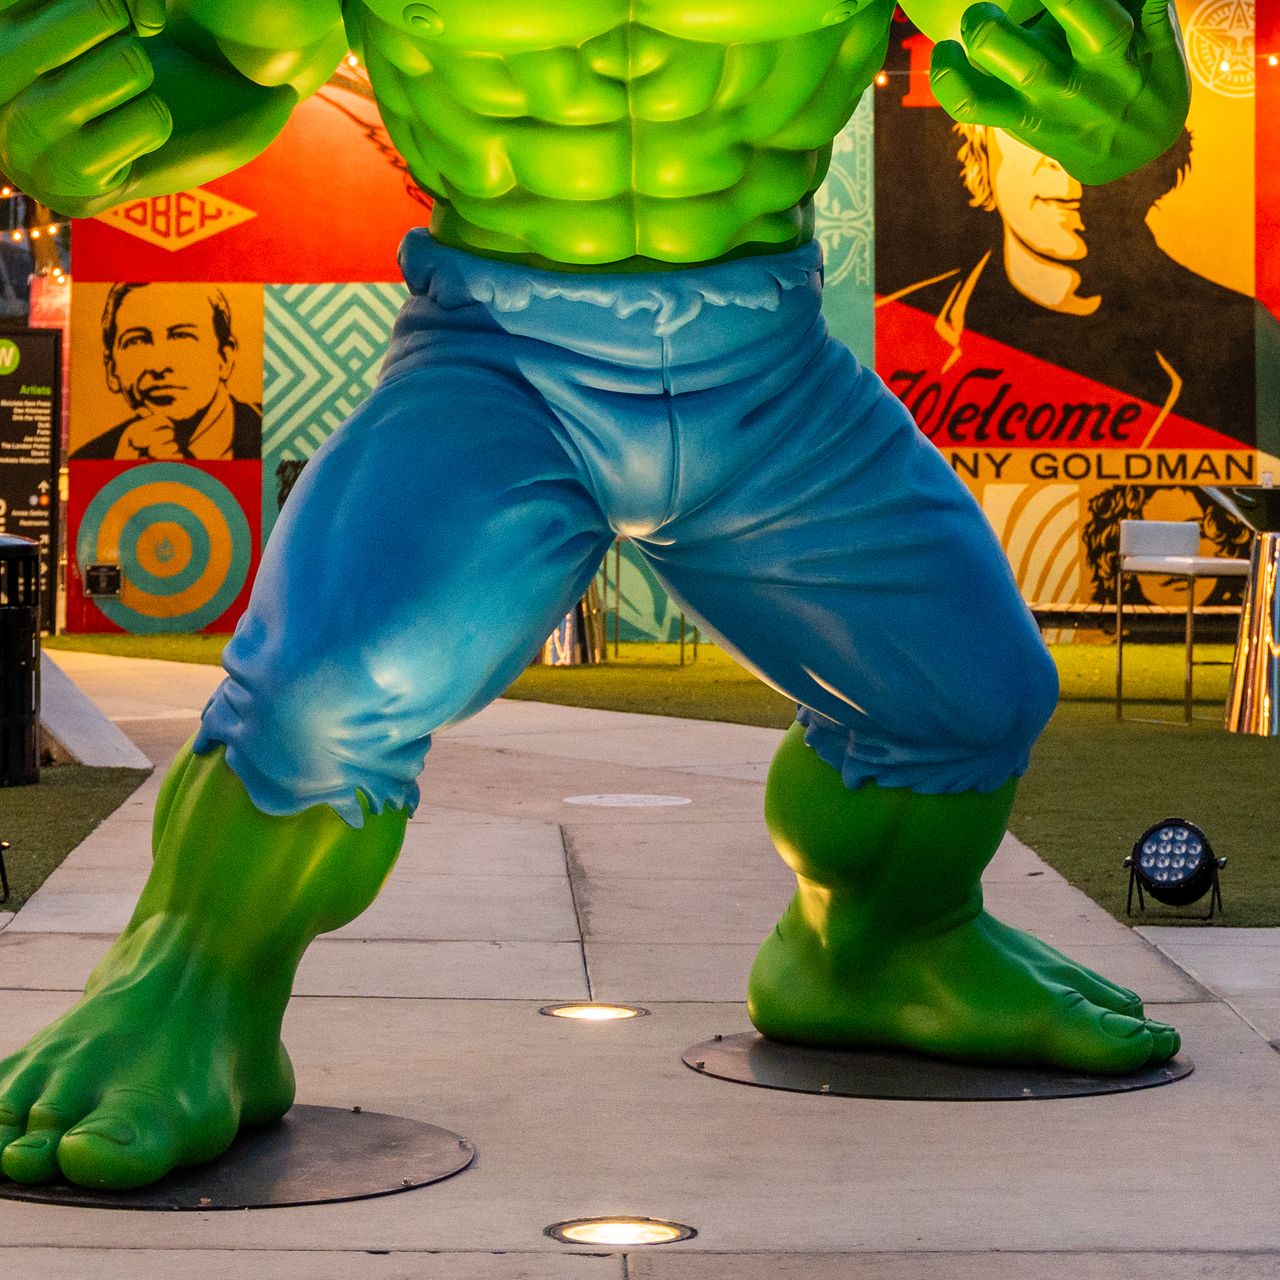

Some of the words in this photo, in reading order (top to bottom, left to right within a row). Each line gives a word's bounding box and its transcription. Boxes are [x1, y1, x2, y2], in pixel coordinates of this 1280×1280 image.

[124, 192, 222, 238] OBEY
[888, 368, 1142, 442] Welcome
[951, 453, 1012, 479] NY
[1031, 453, 1255, 480] GOLDMAN
